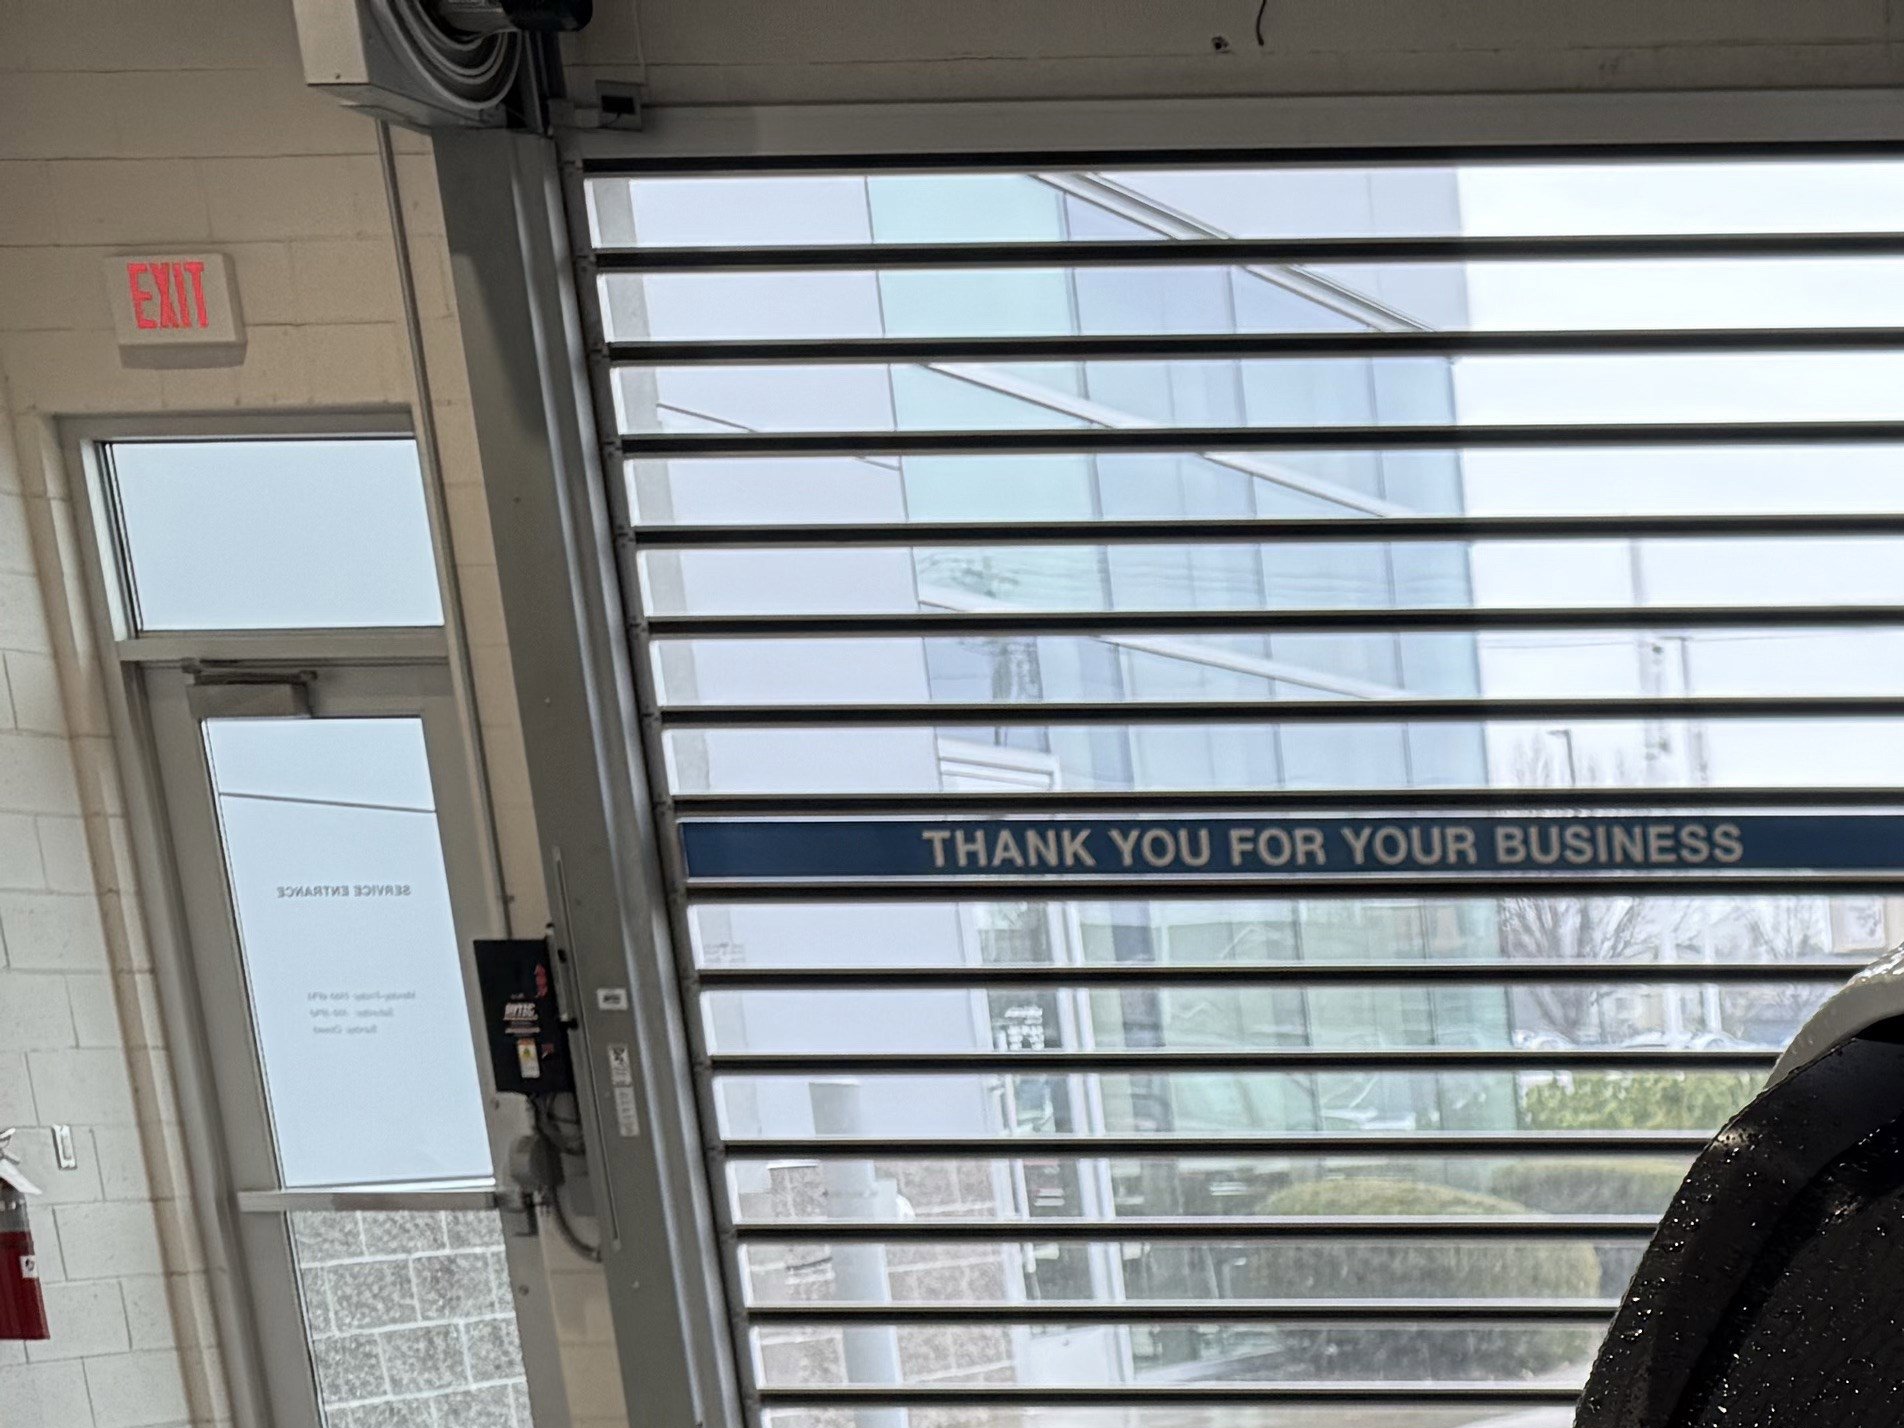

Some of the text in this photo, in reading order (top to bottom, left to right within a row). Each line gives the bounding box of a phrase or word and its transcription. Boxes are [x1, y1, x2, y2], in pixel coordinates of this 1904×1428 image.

[127, 261, 208, 329] EXIT
[922, 824, 1744, 868] THANK YOU FOR YOUR BUSINESS
